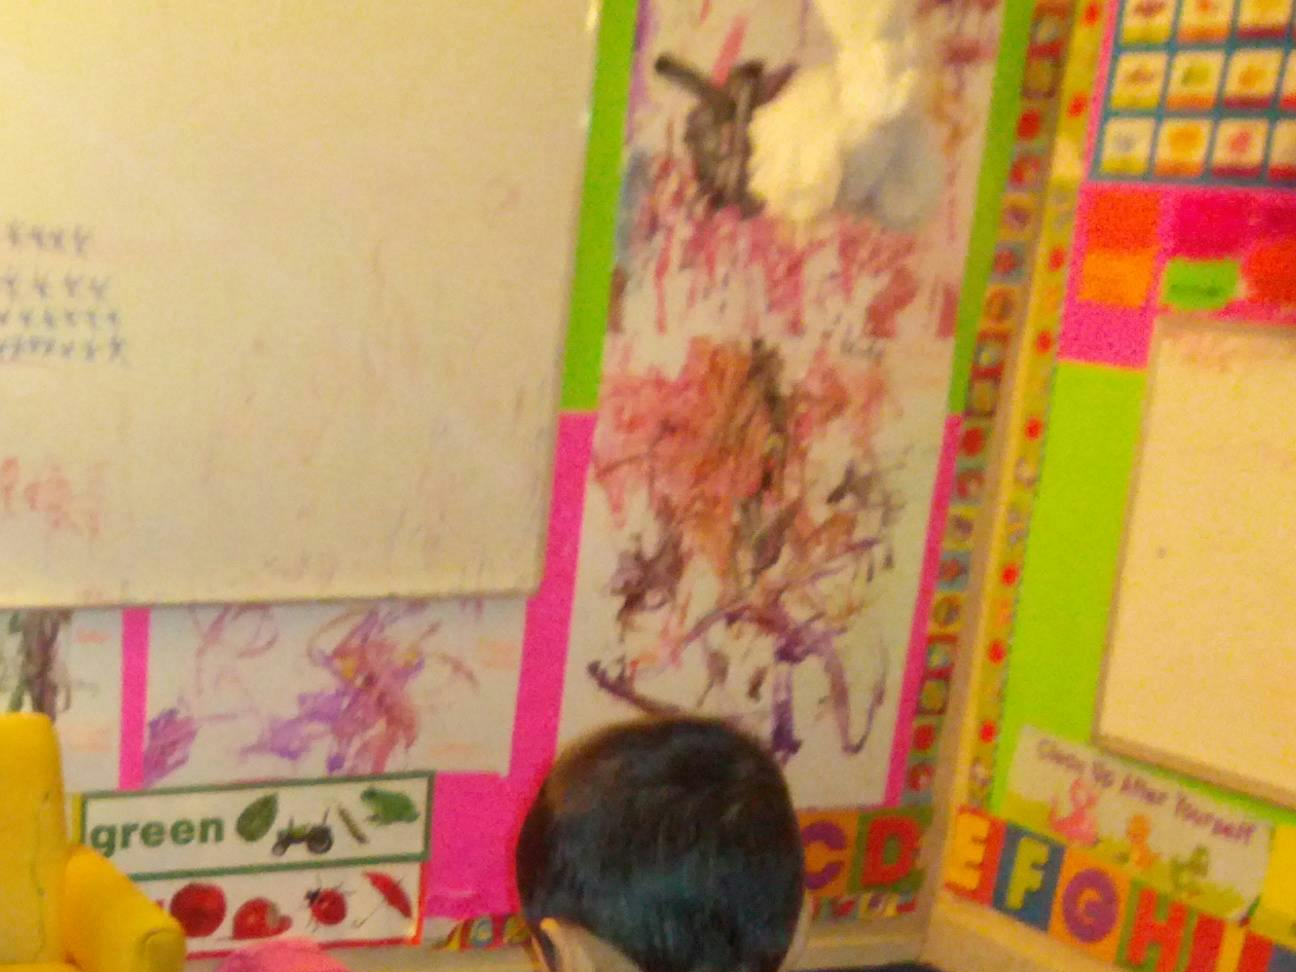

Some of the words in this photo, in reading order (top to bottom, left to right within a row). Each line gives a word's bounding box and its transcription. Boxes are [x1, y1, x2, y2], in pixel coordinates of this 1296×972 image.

[89, 815, 226, 858] green
[860, 814, 922, 888] D
[953, 811, 992, 892] E
[1006, 835, 1051, 911] F
[1061, 866, 1121, 944] G
